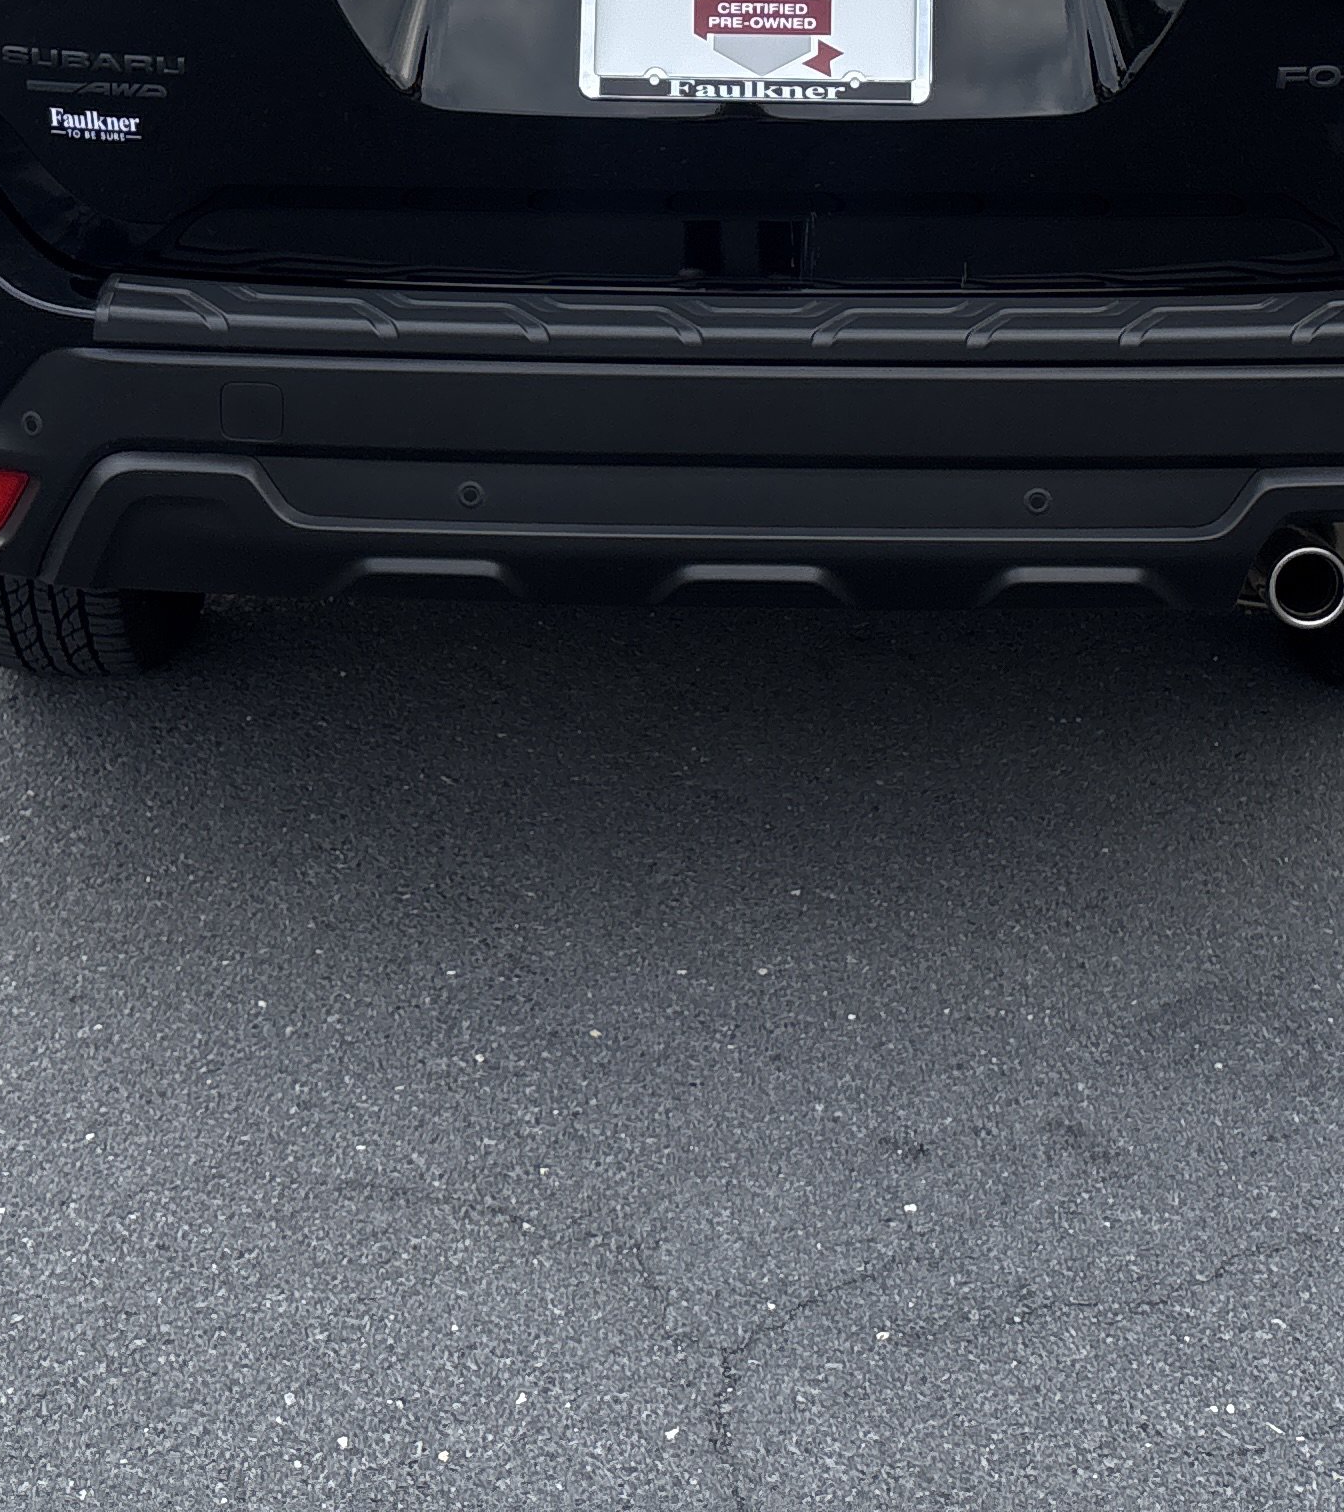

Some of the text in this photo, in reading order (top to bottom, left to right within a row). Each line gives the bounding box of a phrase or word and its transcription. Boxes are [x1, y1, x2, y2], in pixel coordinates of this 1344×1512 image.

[717, 2, 808, 15] CERTIFIED
[708, 17, 817, 29] PRE-OWNED
[1, 45, 186, 75] SUBARU
[77, 81, 168, 99] AWD
[667, 79, 846, 100] Faulkner
[49, 107, 140, 132] Faulkner
[67, 129, 126, 142] TO BE SURE
